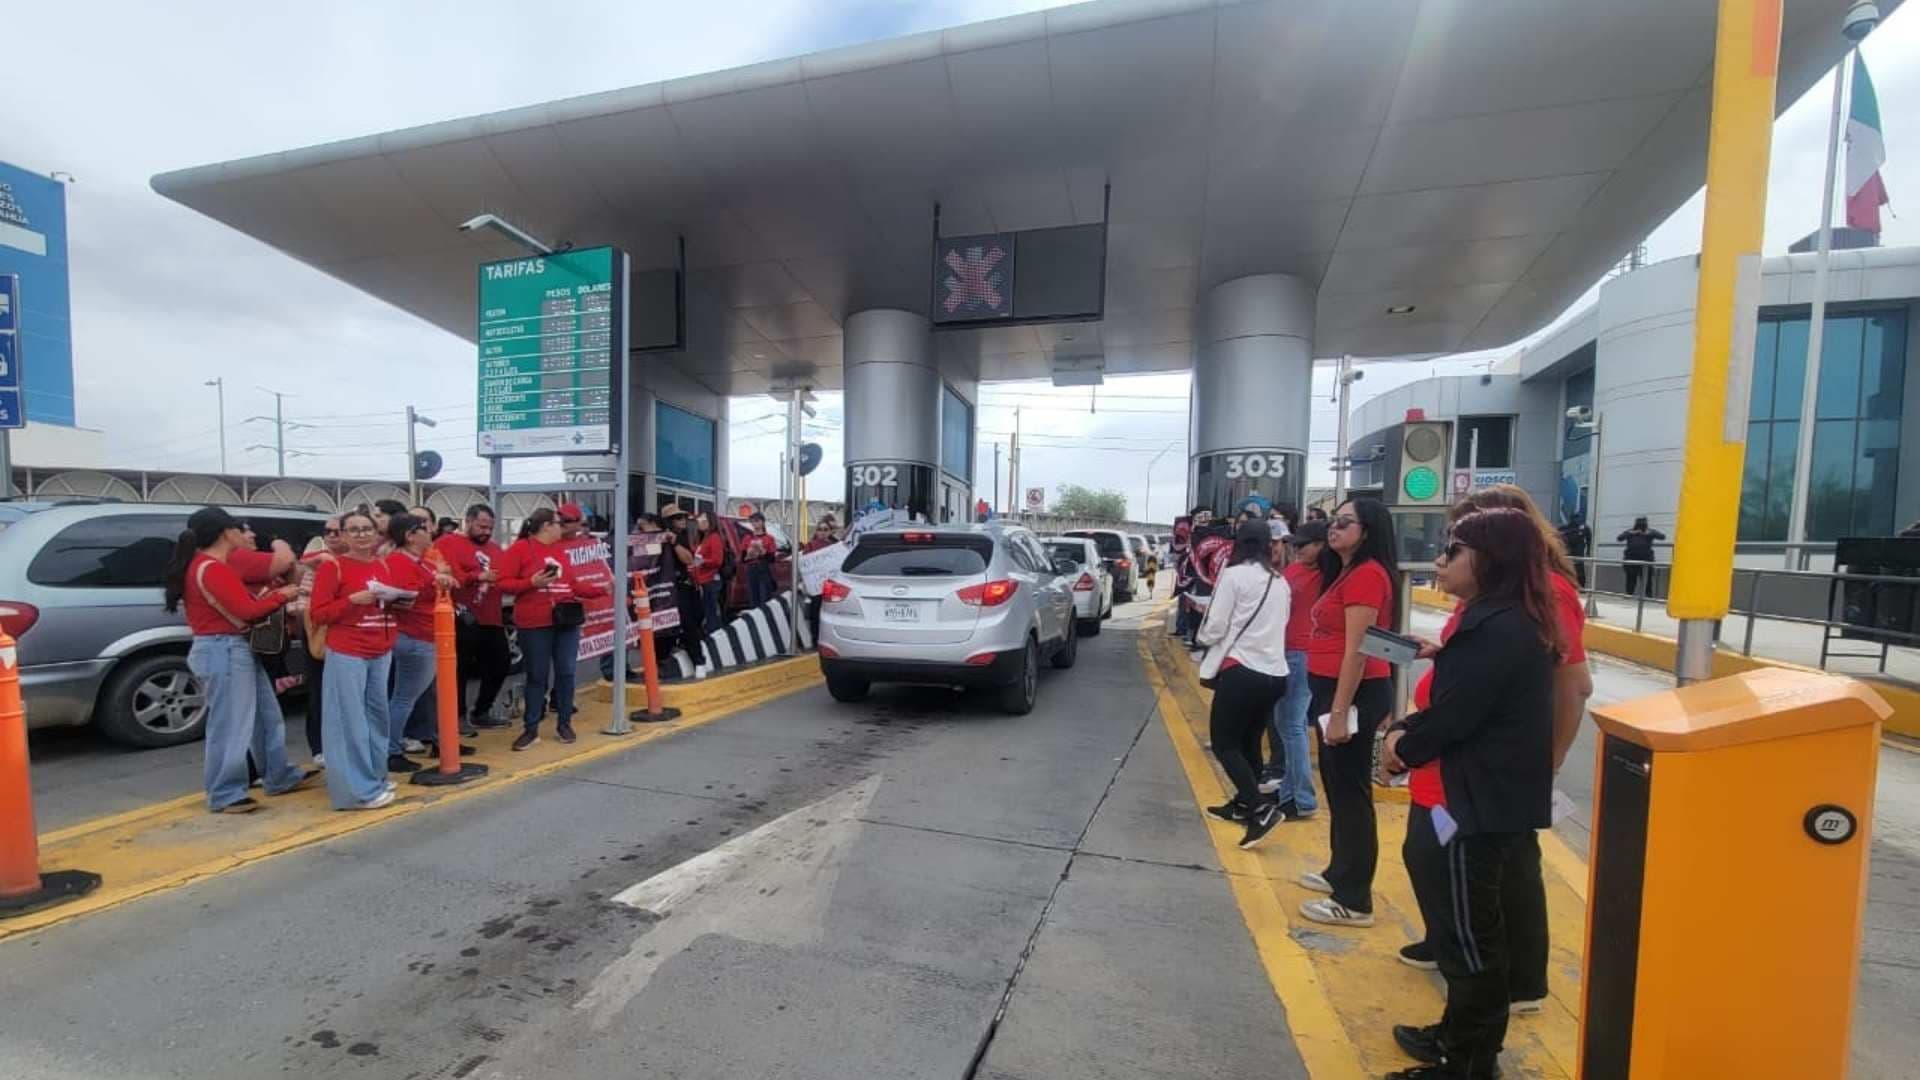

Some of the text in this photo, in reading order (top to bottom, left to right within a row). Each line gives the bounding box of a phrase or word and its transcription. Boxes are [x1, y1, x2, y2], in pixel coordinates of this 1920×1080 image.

[486, 259, 545, 280] TARIFAS
[545, 288, 571, 298] PESOS
[852, 465, 898, 487] 302
[1226, 453, 1285, 478] 303
[565, 541, 612, 566] XIGIMOS
